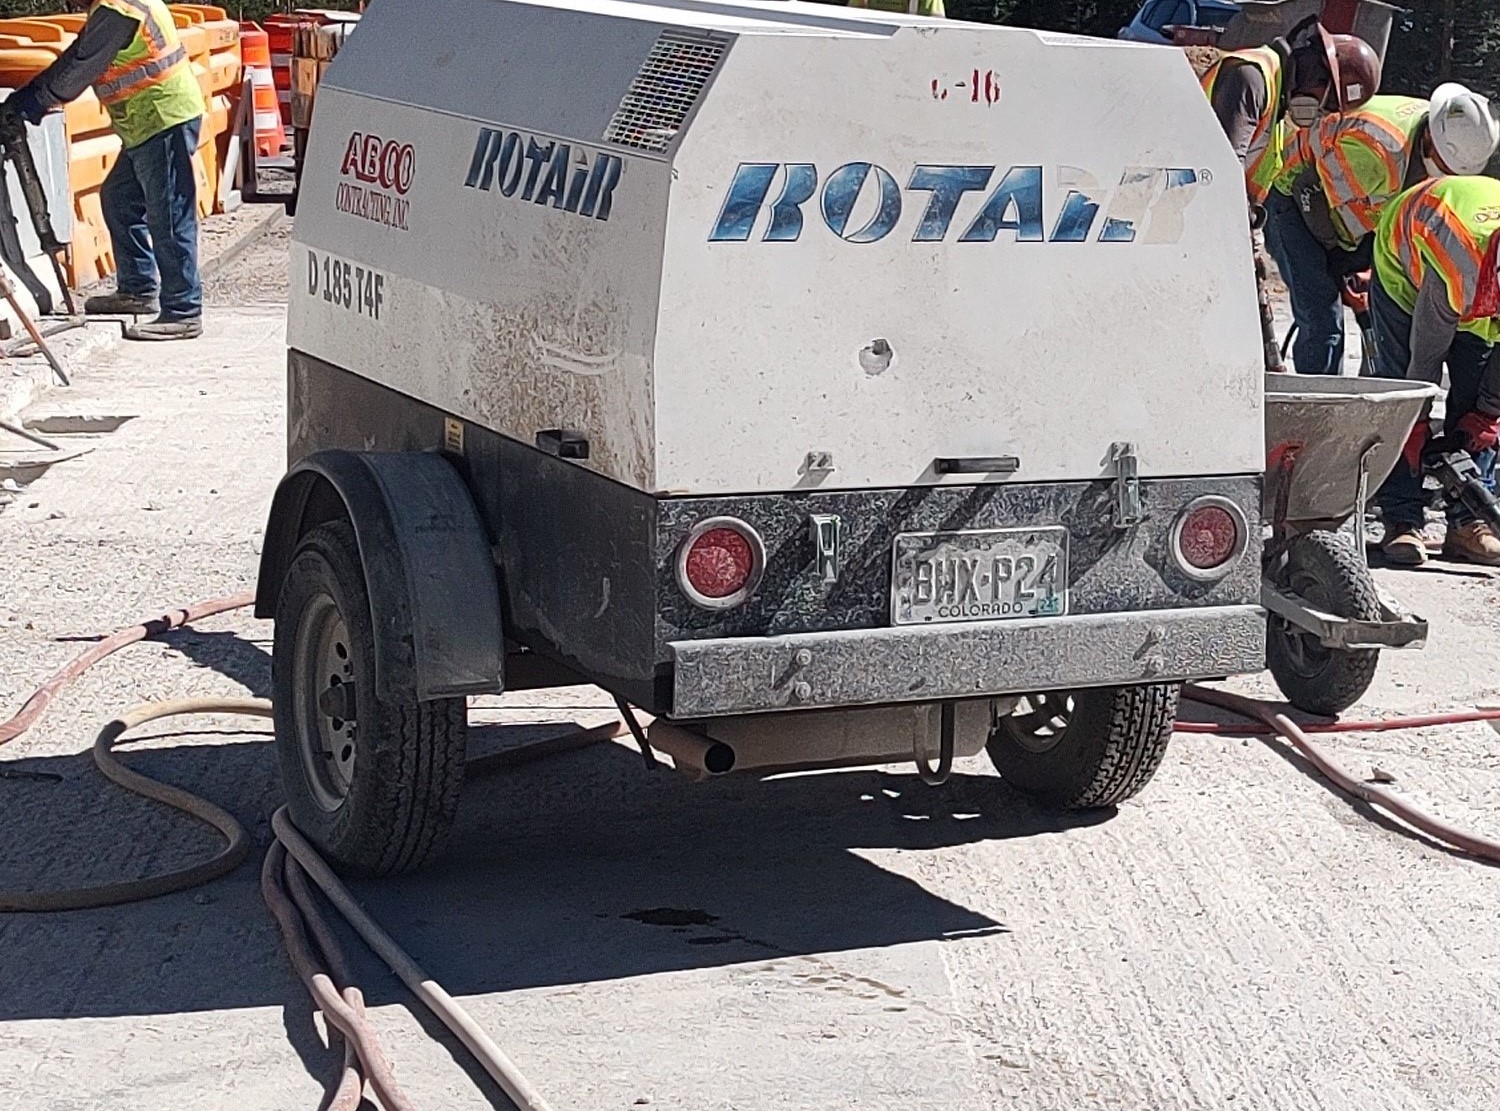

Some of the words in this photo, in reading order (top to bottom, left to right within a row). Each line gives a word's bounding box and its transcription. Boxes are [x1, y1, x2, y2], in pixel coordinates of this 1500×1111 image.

[341, 131, 416, 195] ABCO
[307, 250, 318, 296] D
[323, 257, 352, 311] 185
[938, 602, 1024, 618] COLORADO
